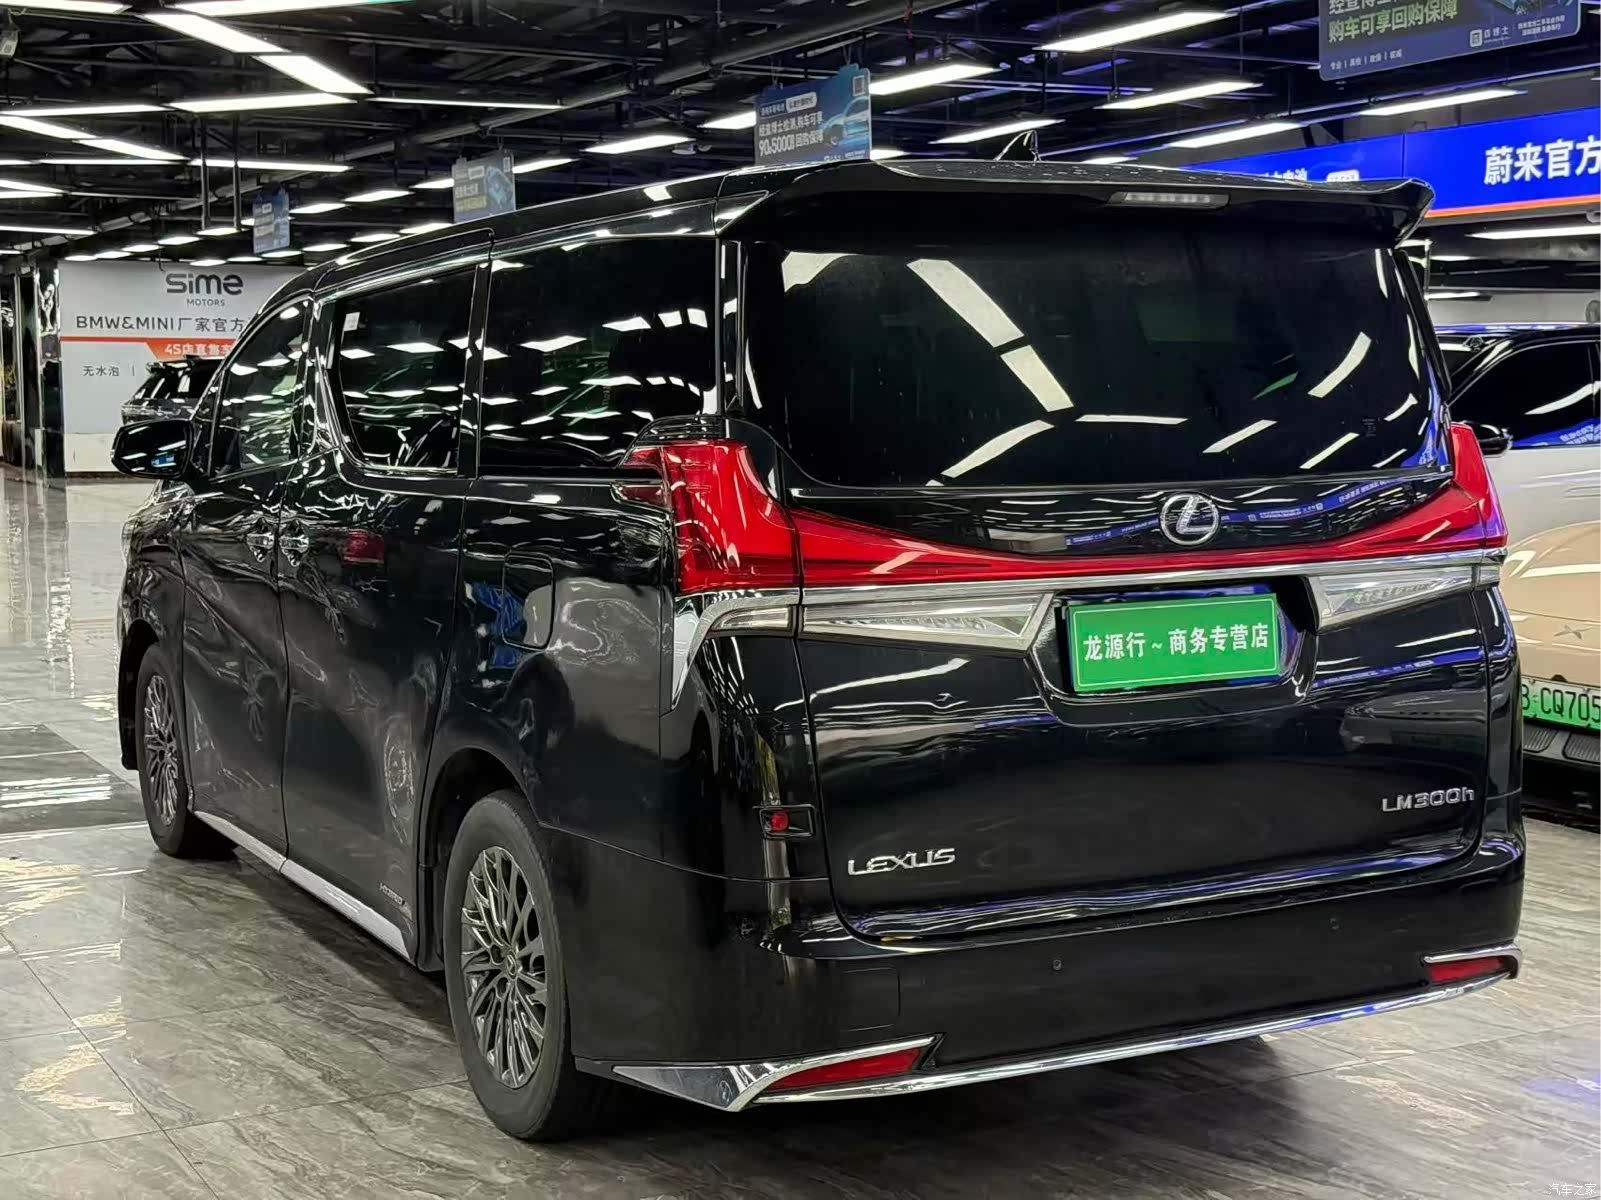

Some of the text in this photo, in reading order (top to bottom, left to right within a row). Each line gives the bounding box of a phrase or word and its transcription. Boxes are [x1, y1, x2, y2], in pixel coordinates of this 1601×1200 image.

[1484, 135, 1601, 186] 蔚来官方
[83, 366, 119, 377] 无水泡
[848, 848, 956, 876] LEXUS
